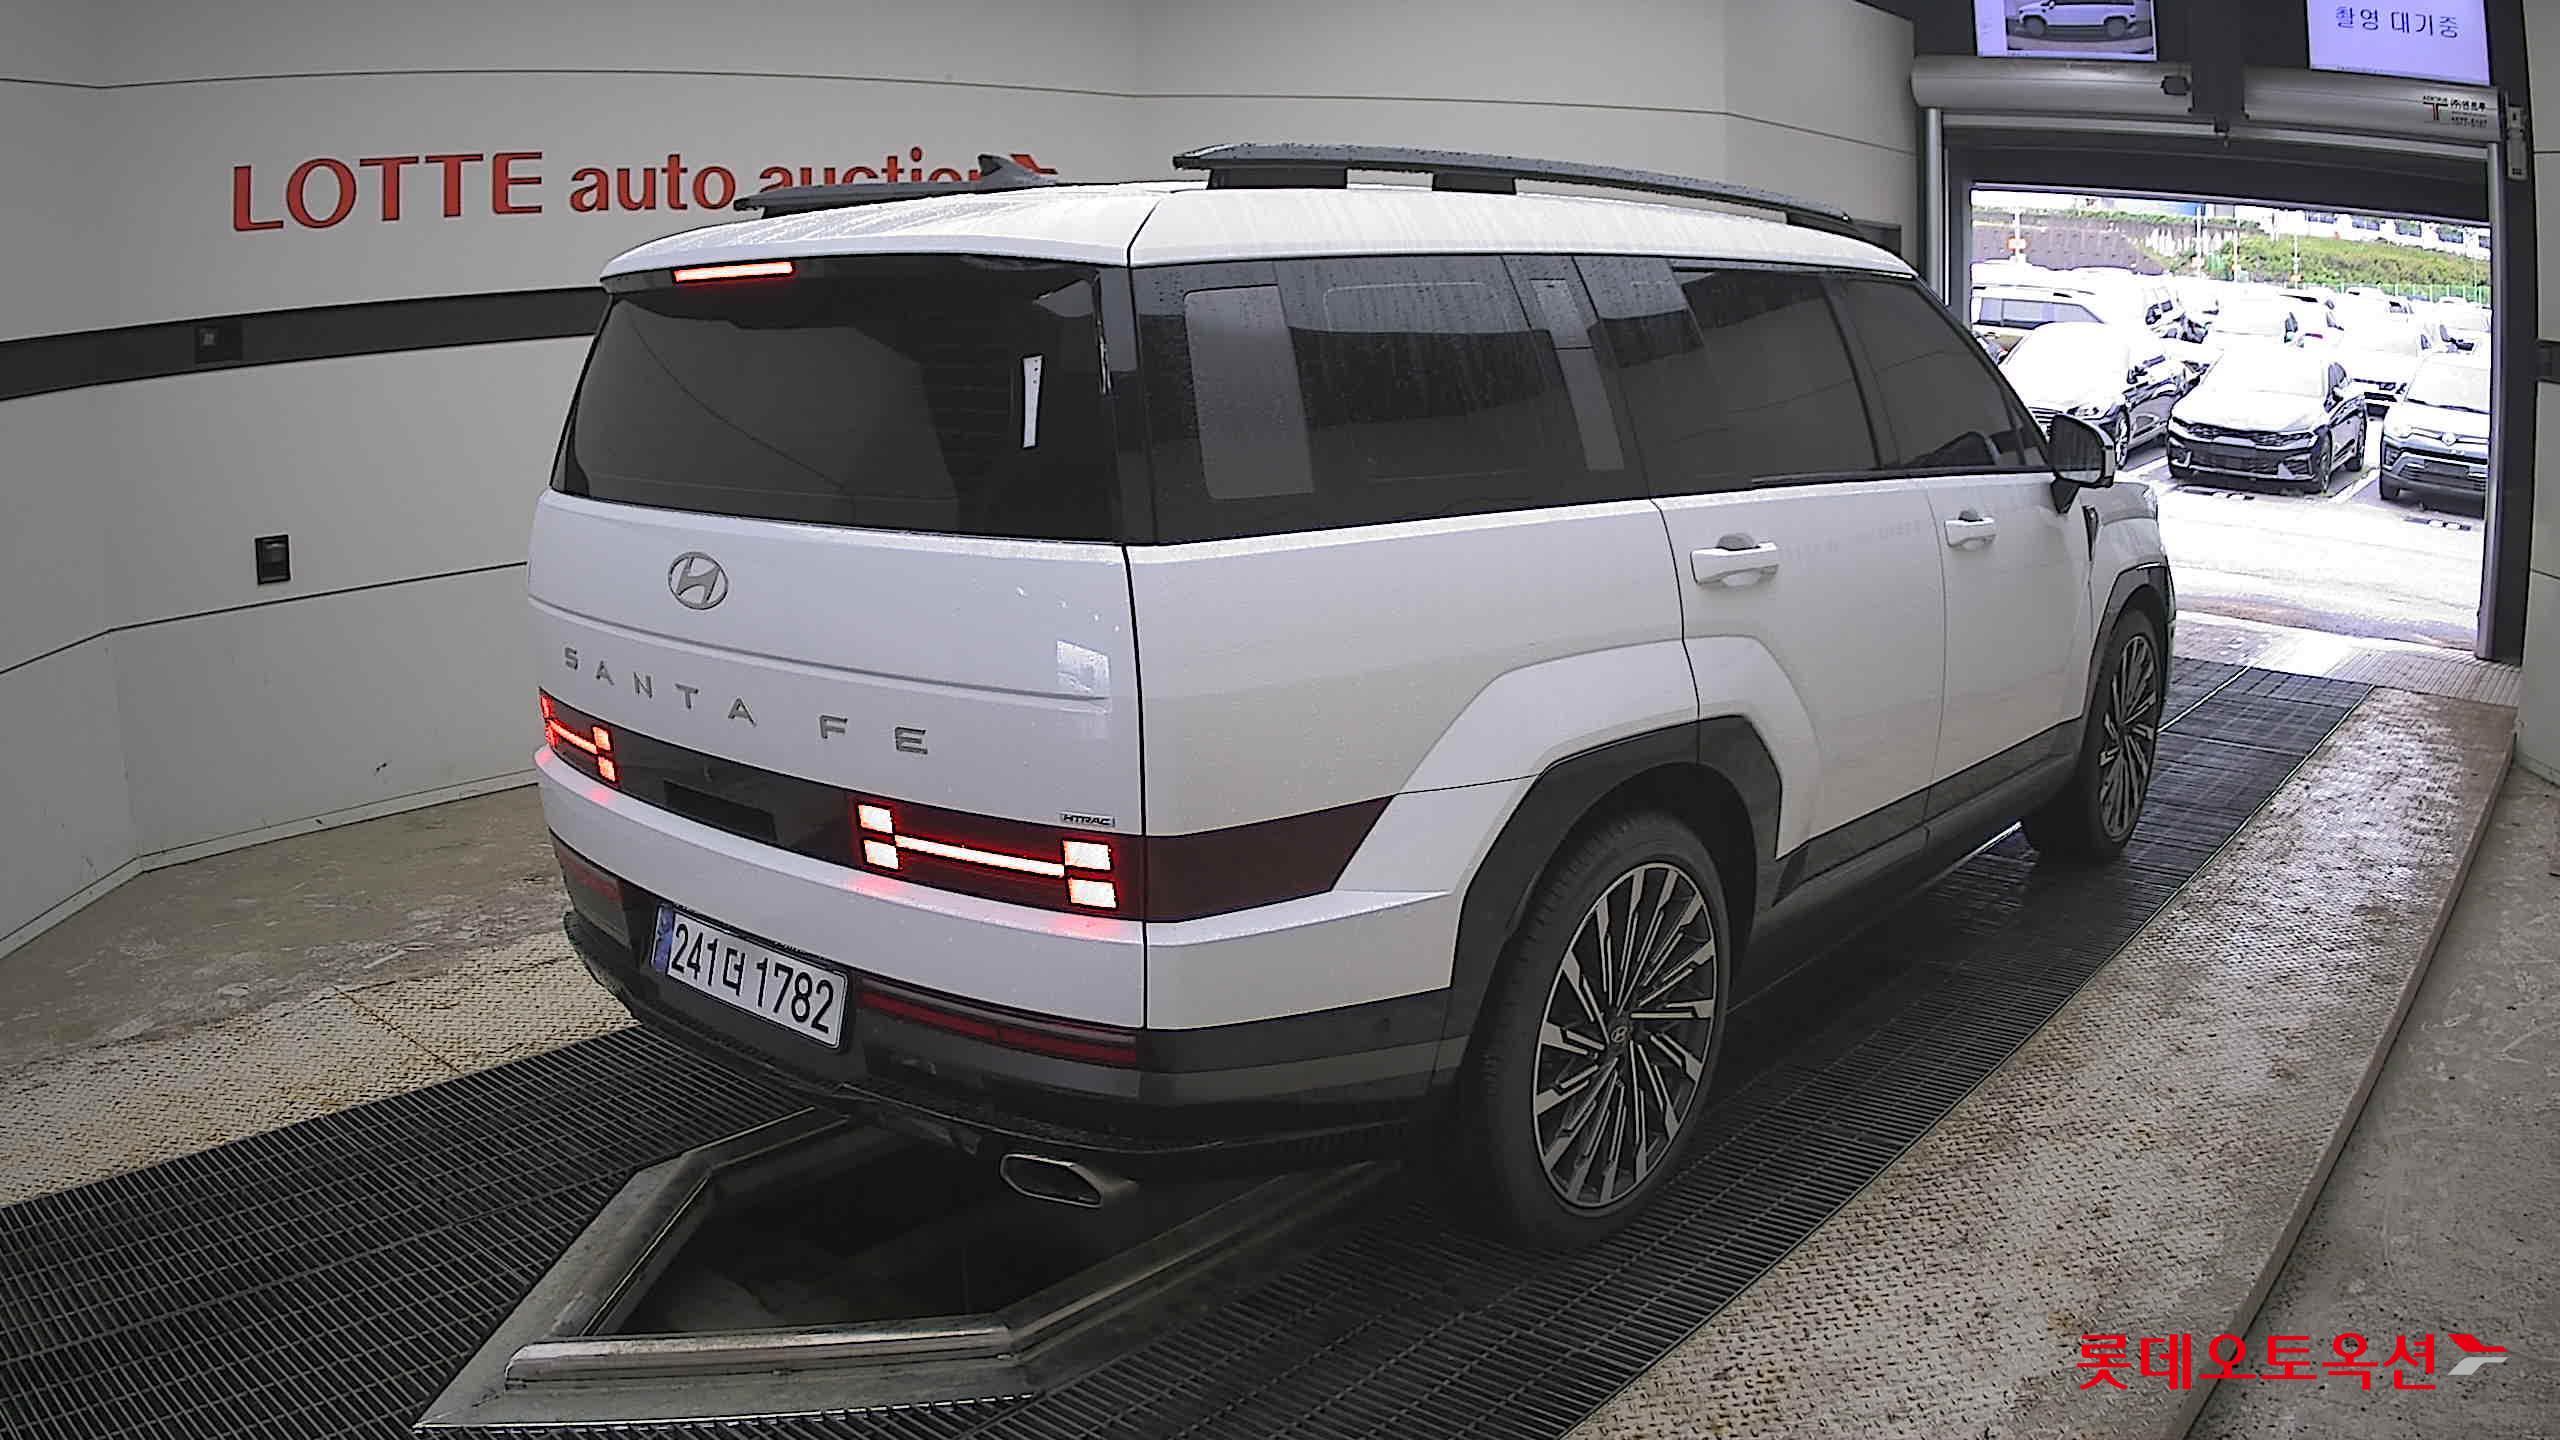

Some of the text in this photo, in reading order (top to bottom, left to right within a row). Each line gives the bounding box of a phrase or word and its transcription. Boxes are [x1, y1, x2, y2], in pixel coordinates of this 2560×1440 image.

[2390, 11, 2459, 39] 대기중
[232, 146, 983, 233] LOTTE auto aucti
[564, 647, 929, 756] SANTA FE
[1062, 813, 1112, 827] HTRAC
[671, 923, 834, 1035] 241더 1782
